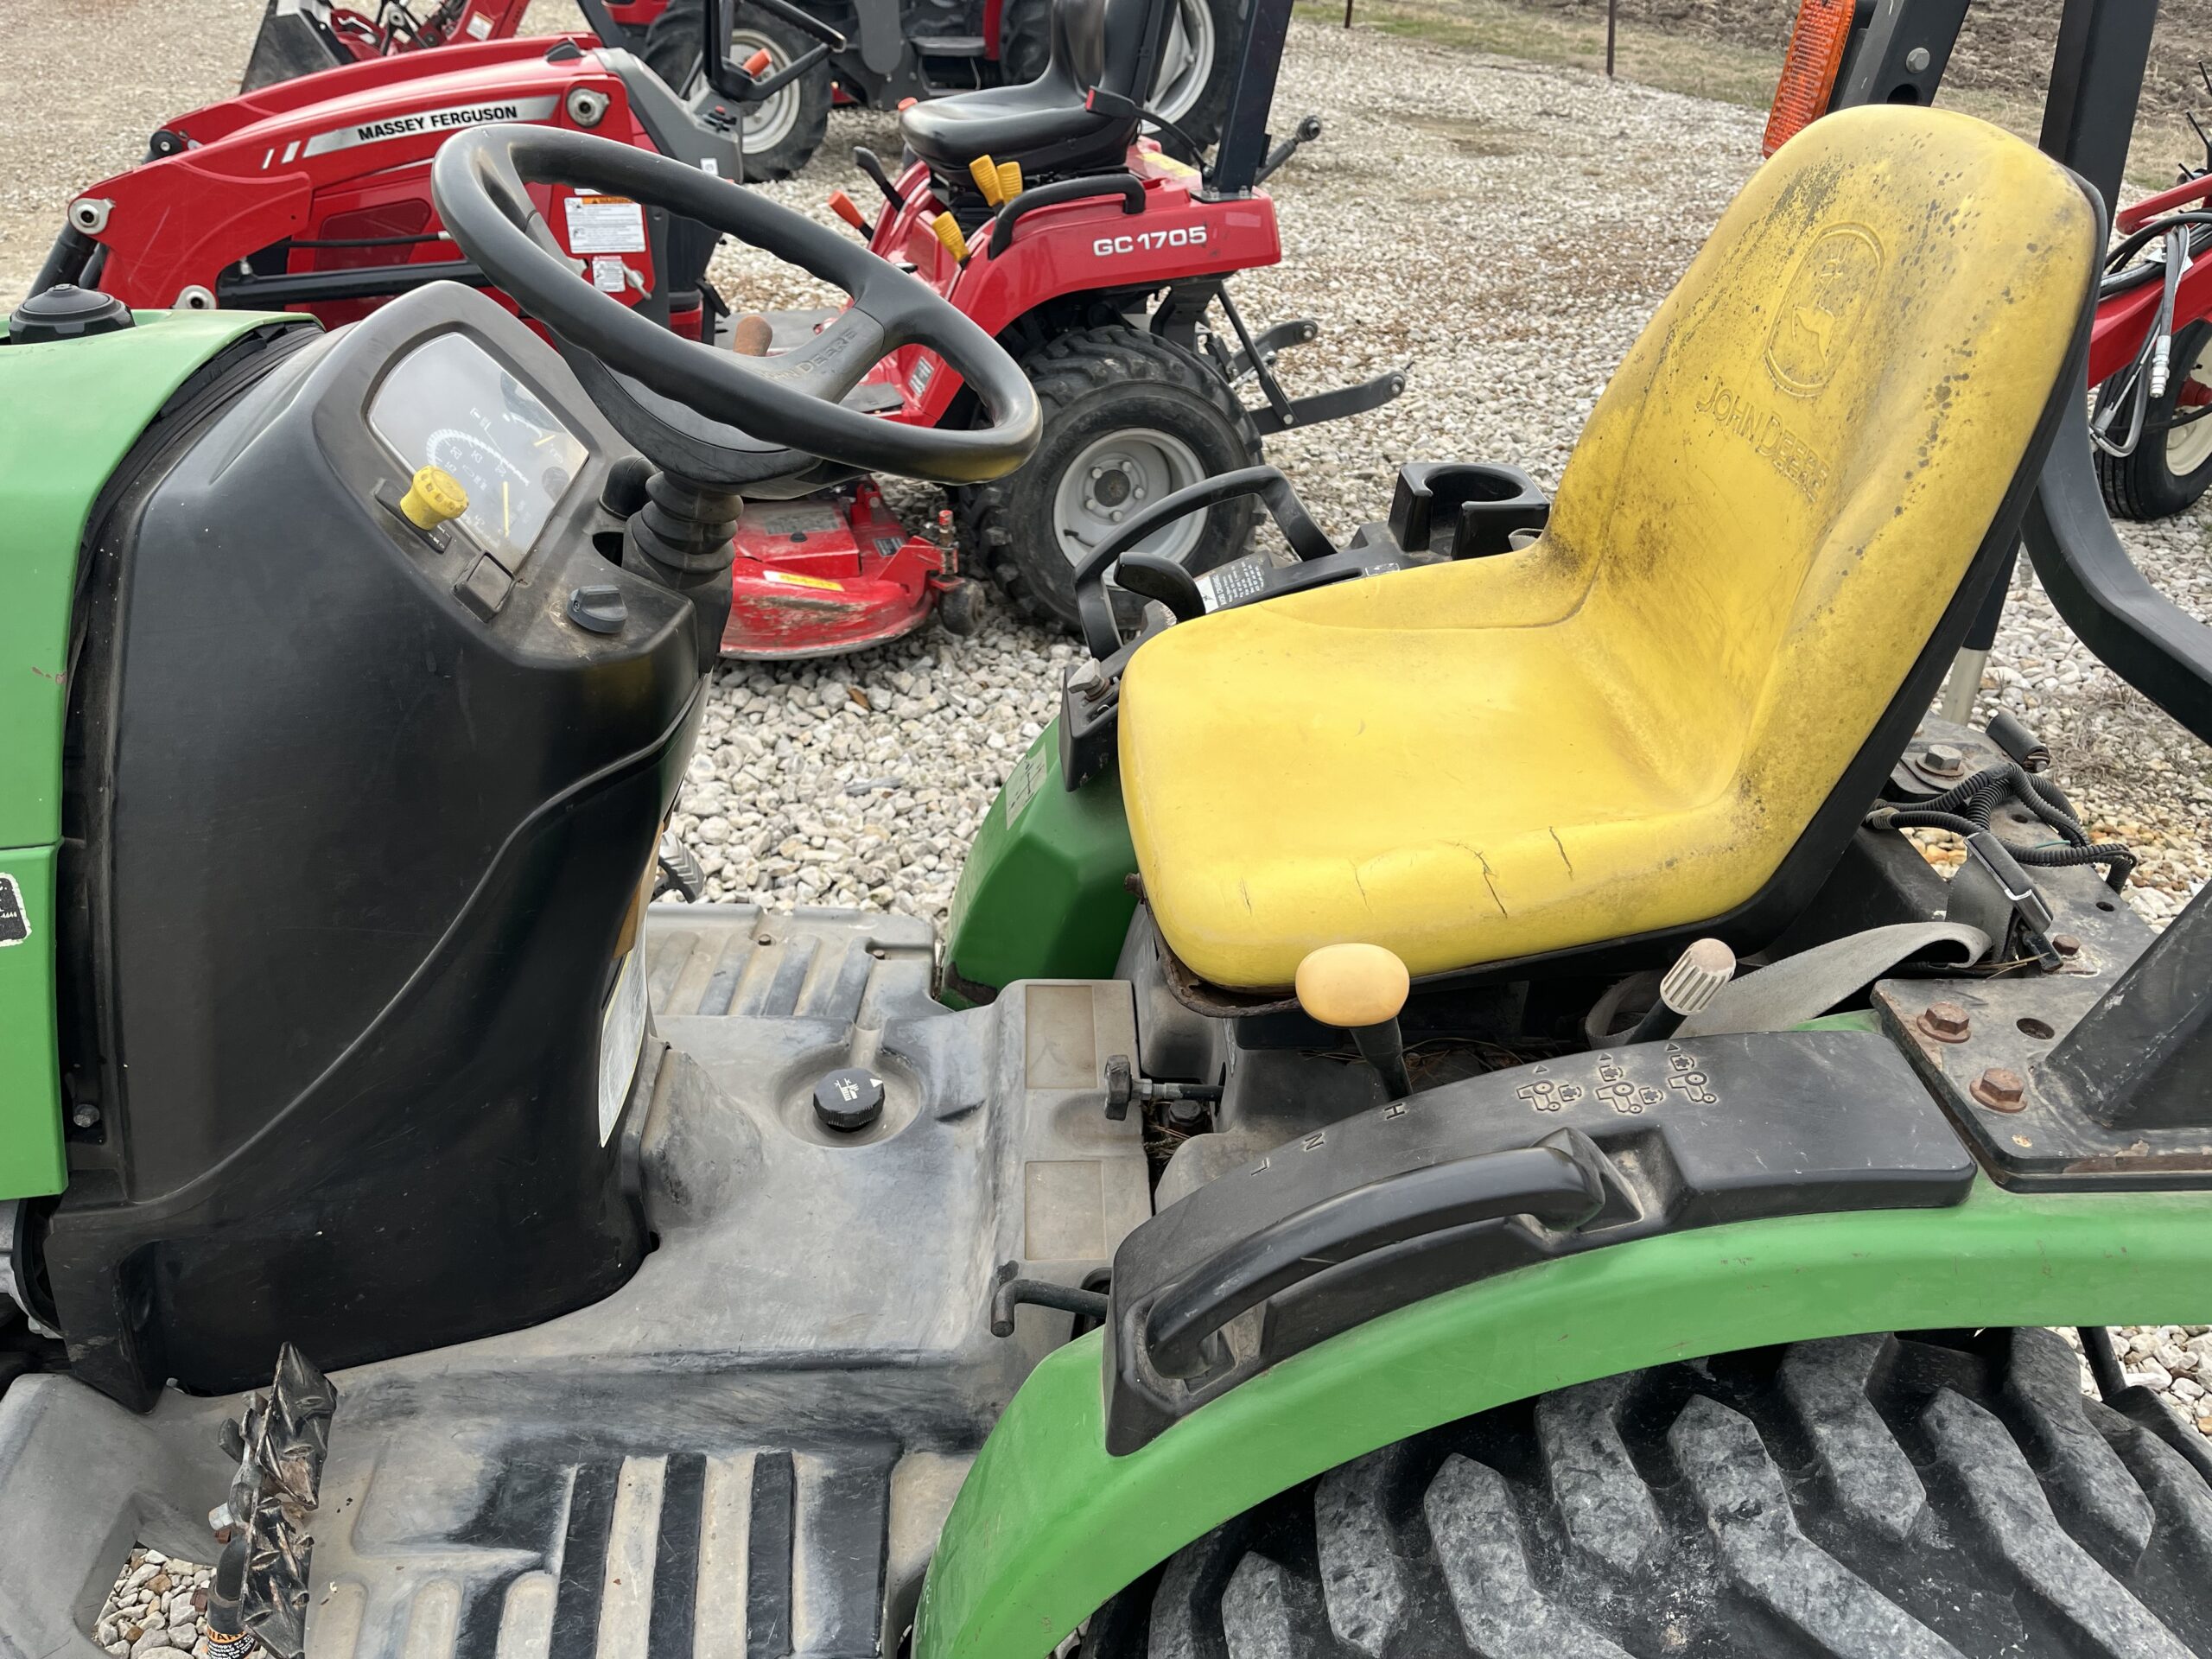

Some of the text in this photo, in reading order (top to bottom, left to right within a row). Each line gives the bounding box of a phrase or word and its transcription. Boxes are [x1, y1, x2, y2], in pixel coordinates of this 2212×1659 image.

[357, 105, 518, 141] MASSEY FERGUSON
[795, 329, 858, 375] DEERE
[1695, 376, 1831, 503] JOHN DEERE
[1384, 1103, 1406, 1120] H
[1305, 1133, 1325, 1151] N
[1250, 1158, 1270, 1176] L
